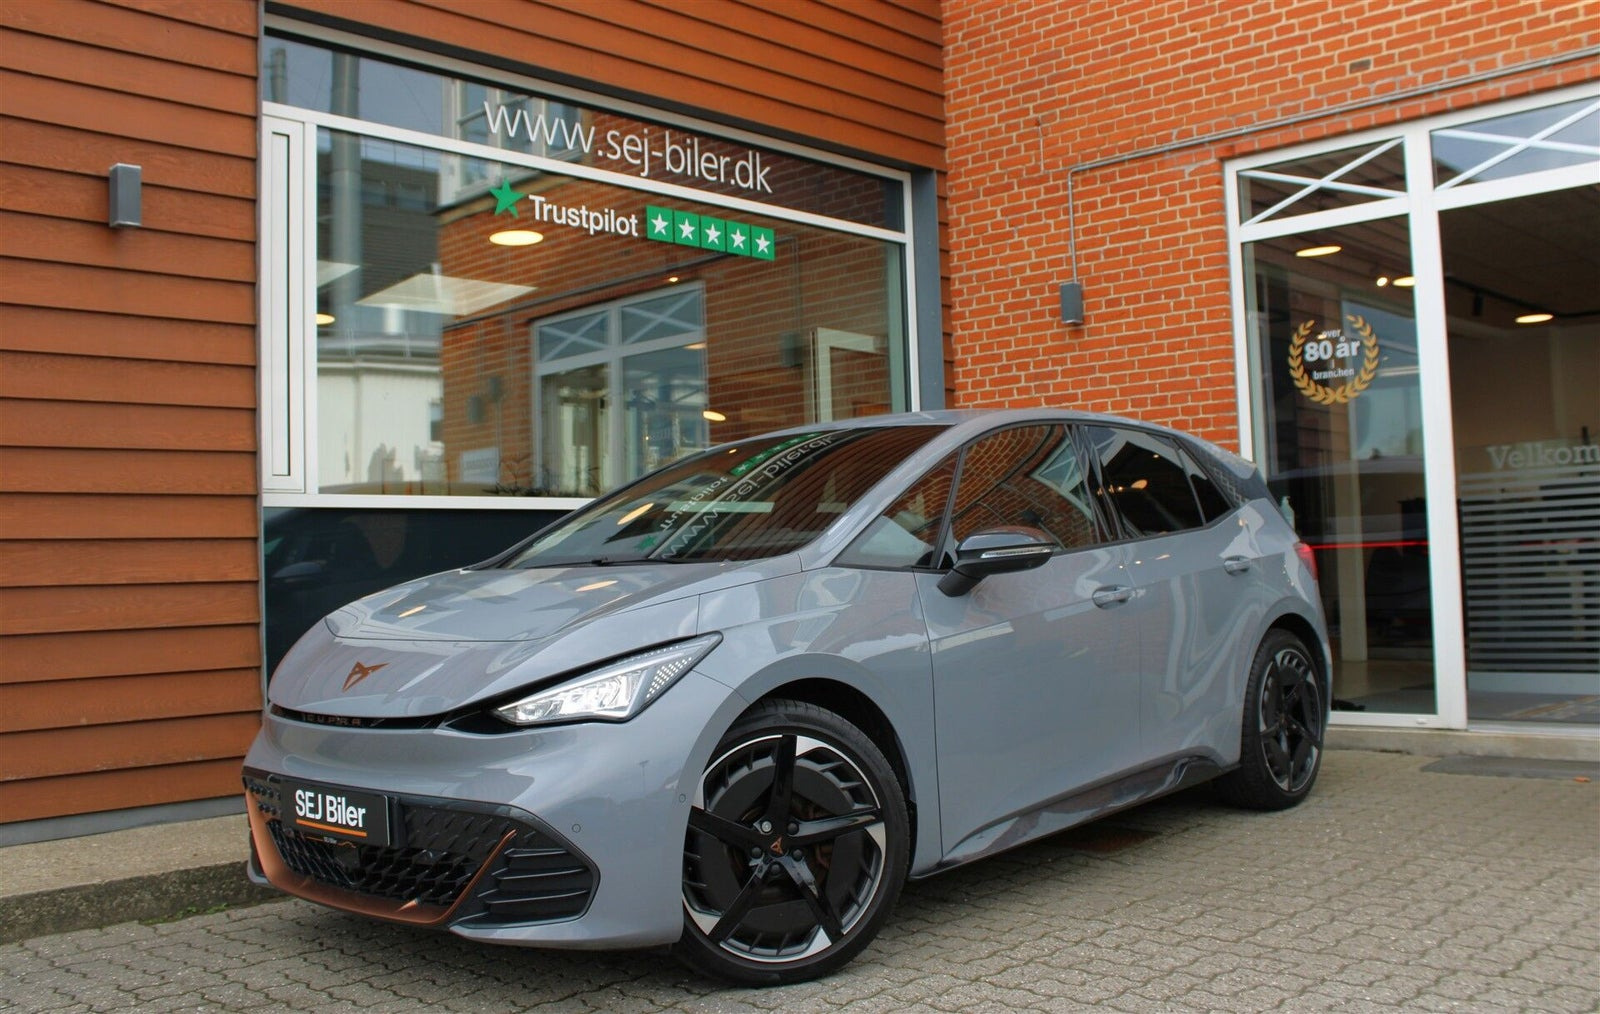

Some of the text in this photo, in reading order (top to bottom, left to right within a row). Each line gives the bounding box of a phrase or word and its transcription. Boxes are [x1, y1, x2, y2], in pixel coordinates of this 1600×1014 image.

[483, 101, 772, 193] www.sej-biler.dk
[528, 194, 638, 236] Trustpilot
[1304, 336, 1361, 362] 80 år
[1313, 368, 1355, 380] branchen
[295, 789, 366, 828] SEJ Biler
